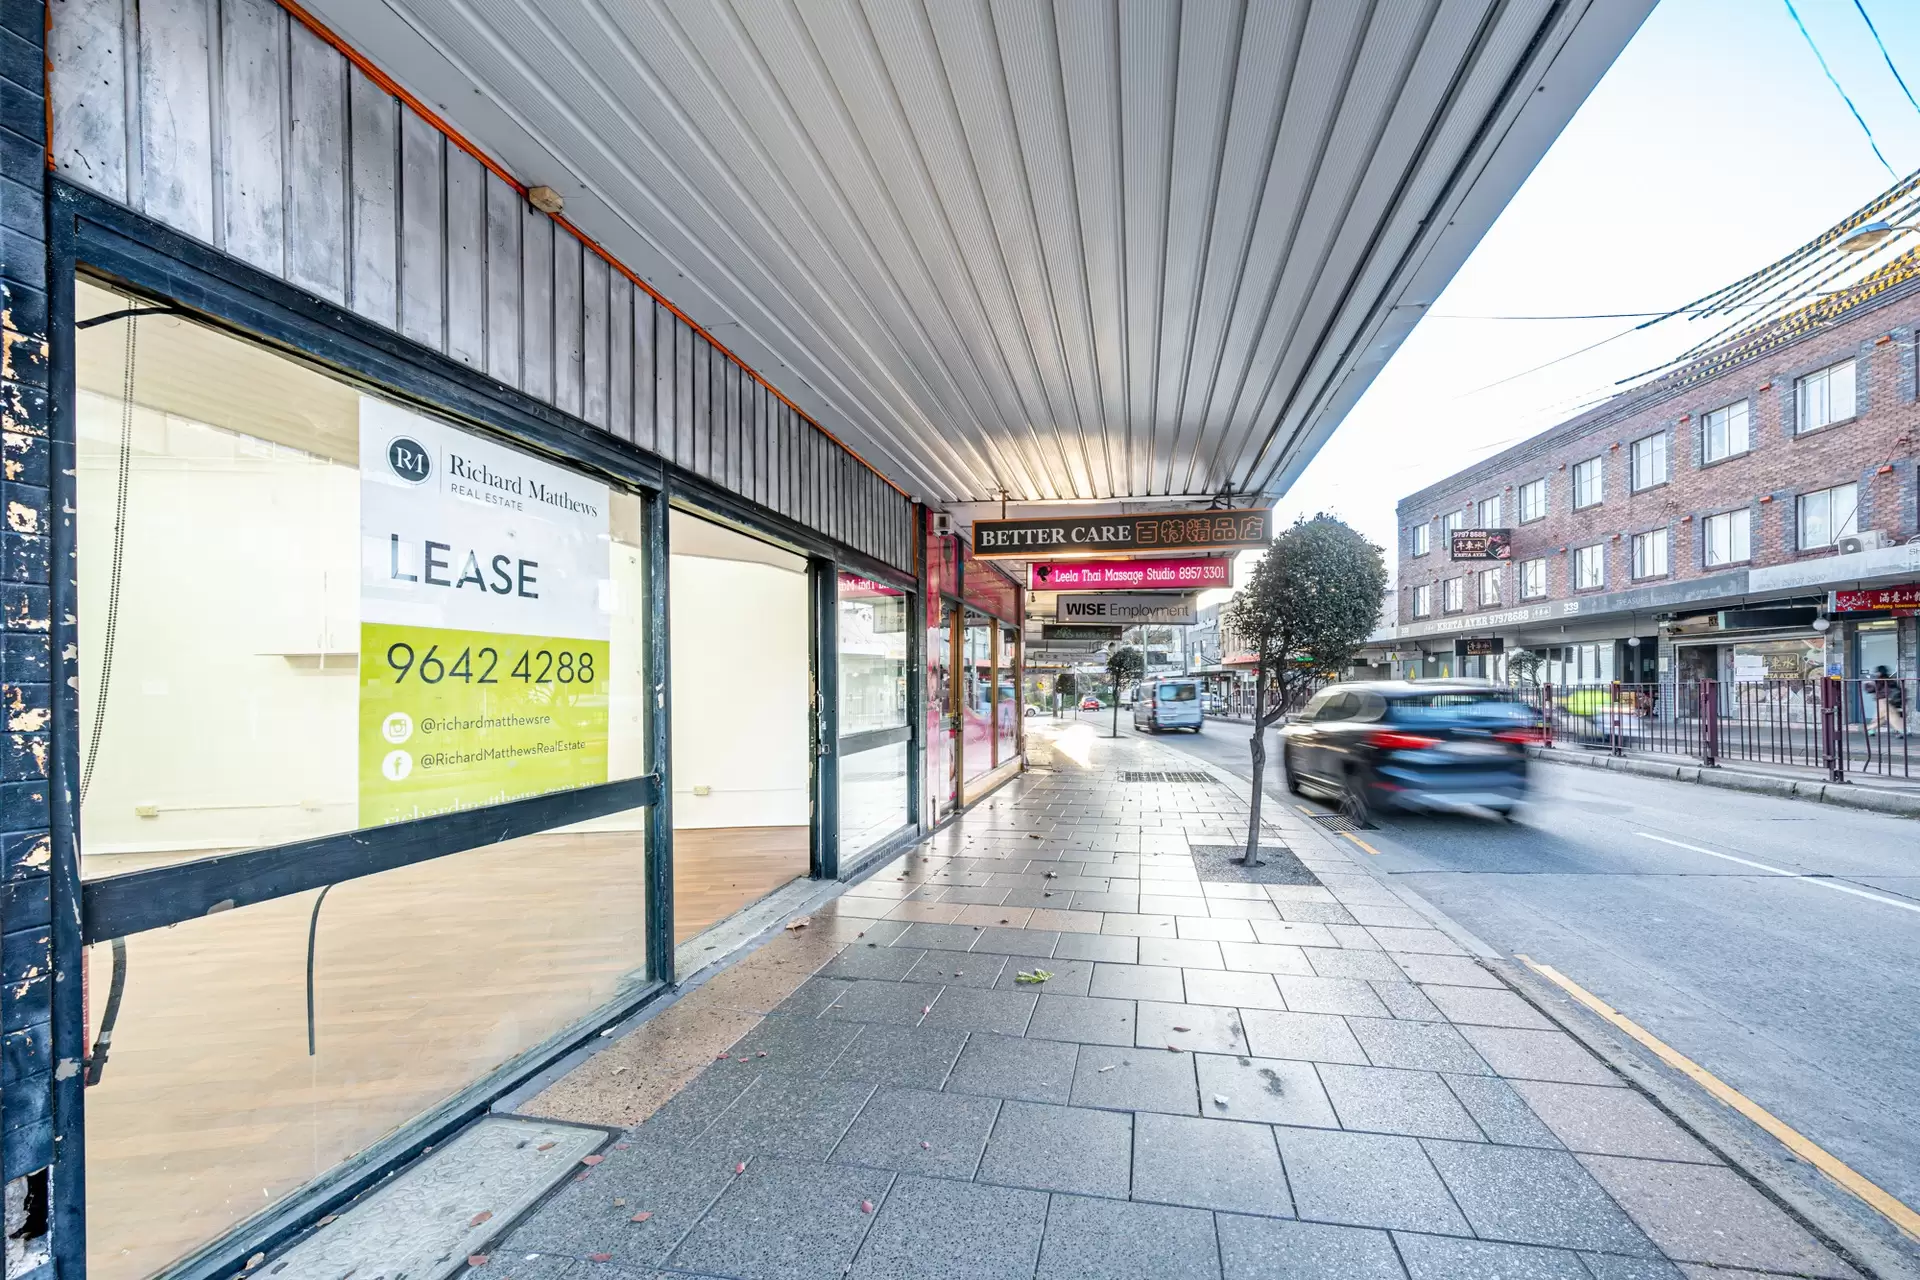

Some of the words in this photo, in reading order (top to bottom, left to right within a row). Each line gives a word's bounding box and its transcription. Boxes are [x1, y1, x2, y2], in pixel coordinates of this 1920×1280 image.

[449, 454, 523, 495] Richard
[529, 479, 598, 518] Matthews
[451, 483, 480, 500] REAL
[485, 493, 524, 511] ESTATE
[980, 528, 1067, 546] BETTER
[1071, 524, 1131, 543] CARE
[1135, 516, 1264, 543] 百特精品店
[391, 533, 539, 599] LEASE
[1055, 569, 1079, 583] Leela
[1081, 568, 1101, 582] Thai
[1105, 567, 1144, 585] Massage
[1146, 566, 1176, 580] Studio
[1179, 566, 1201, 580] 8957
[1203, 565, 1225, 579] 3301
[1066, 602, 1106, 616] WISE
[1109, 602, 1189, 618] Employment
[1563, 602, 1579, 611] 339
[1075, 631, 1111, 639] MASSAGE
[1437, 619, 1463, 632] KRETA
[1463, 616, 1488, 629] AYER
[387, 642, 498, 684] 9642
[510, 649, 595, 684] 4288
[421, 713, 551, 734] @richardmatthewsre
[421, 740, 586, 769] @RichardMatthewsRealEstate
